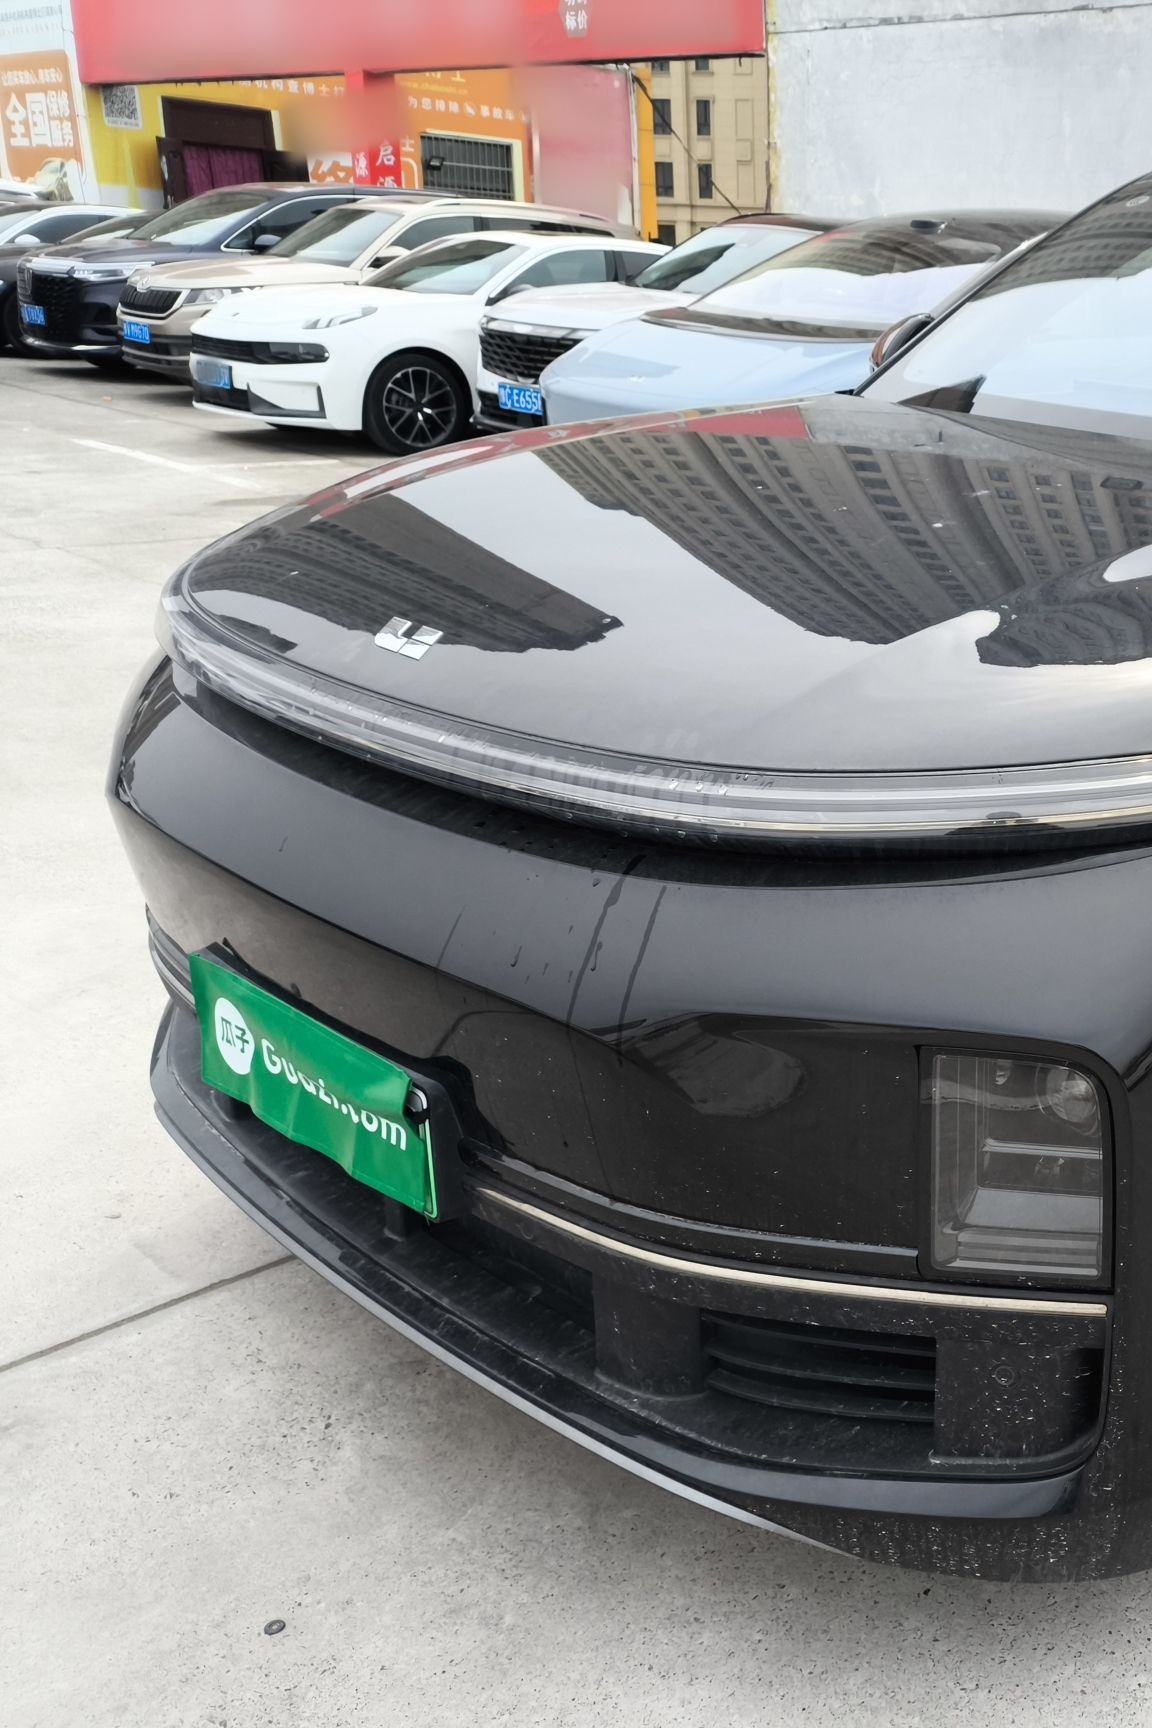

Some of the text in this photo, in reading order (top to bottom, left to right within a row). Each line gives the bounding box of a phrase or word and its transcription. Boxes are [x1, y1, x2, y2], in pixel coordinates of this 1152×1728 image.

[565, 9, 588, 30] 标价
[47, 89, 70, 118] 保修
[5, 91, 52, 147] 全国
[50, 119, 74, 147] 服务
[219, 1015, 250, 1054] 瓜子
